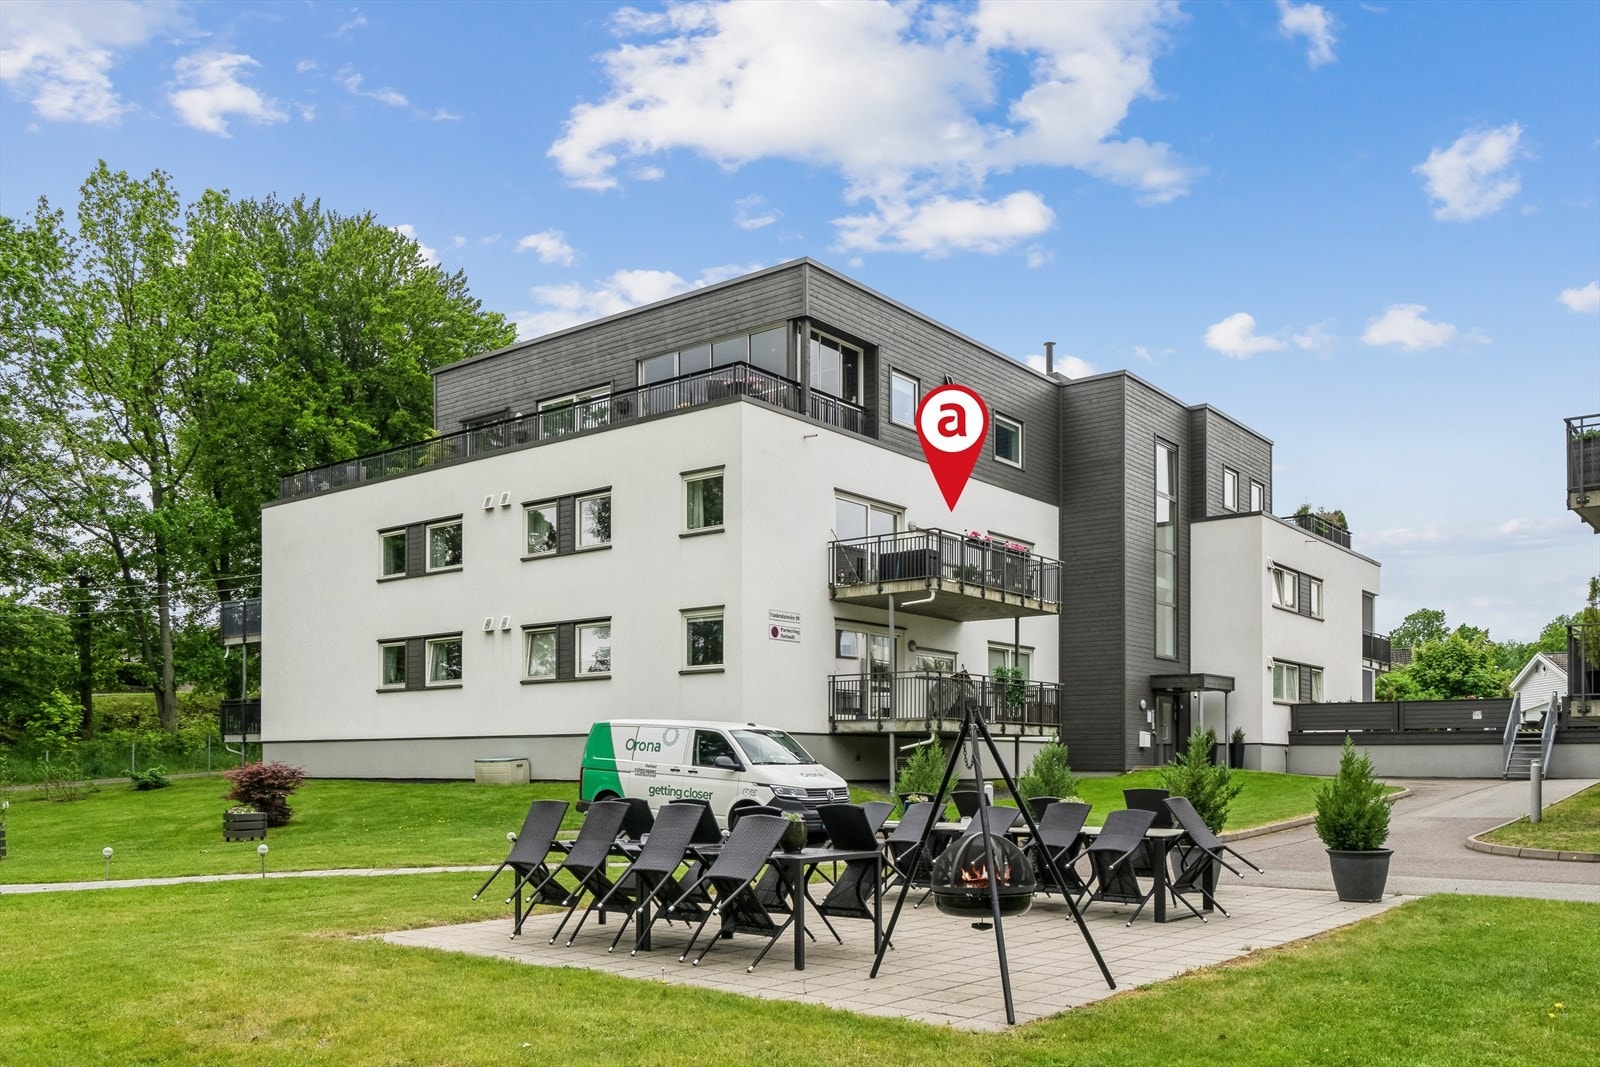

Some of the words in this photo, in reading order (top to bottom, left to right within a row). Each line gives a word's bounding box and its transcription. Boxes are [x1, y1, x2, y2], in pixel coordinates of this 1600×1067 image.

[625, 738, 661, 752] Orona
[648, 785, 682, 799] getting
[683, 787, 713, 800] closer
